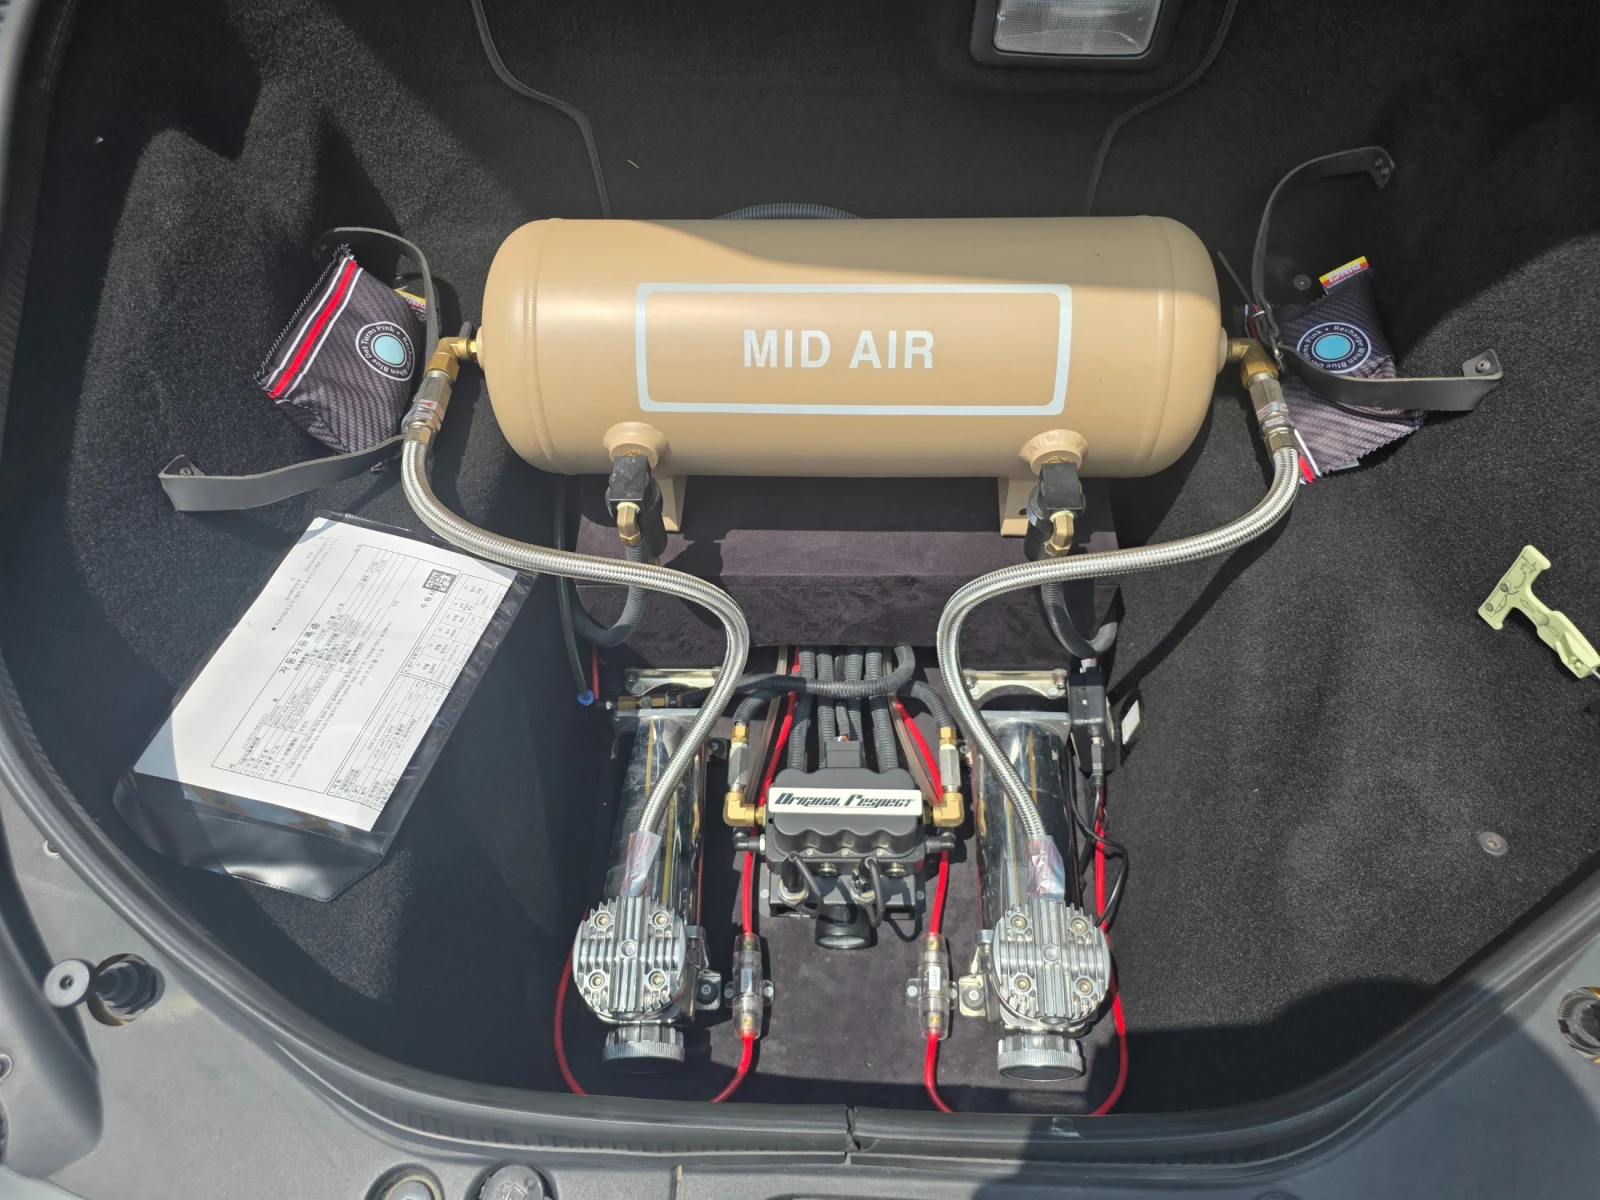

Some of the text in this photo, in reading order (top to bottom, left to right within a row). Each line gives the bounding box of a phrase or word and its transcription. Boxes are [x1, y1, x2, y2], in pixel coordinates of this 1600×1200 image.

[361, 328, 377, 344] Turns
[1305, 330, 1323, 343] Pink
[1333, 325, 1363, 347] Recharge
[361, 346, 373, 359] Dot
[743, 329, 935, 369] MID AIR
[1347, 347, 1365, 364] When
[372, 359, 389, 372] Blue
